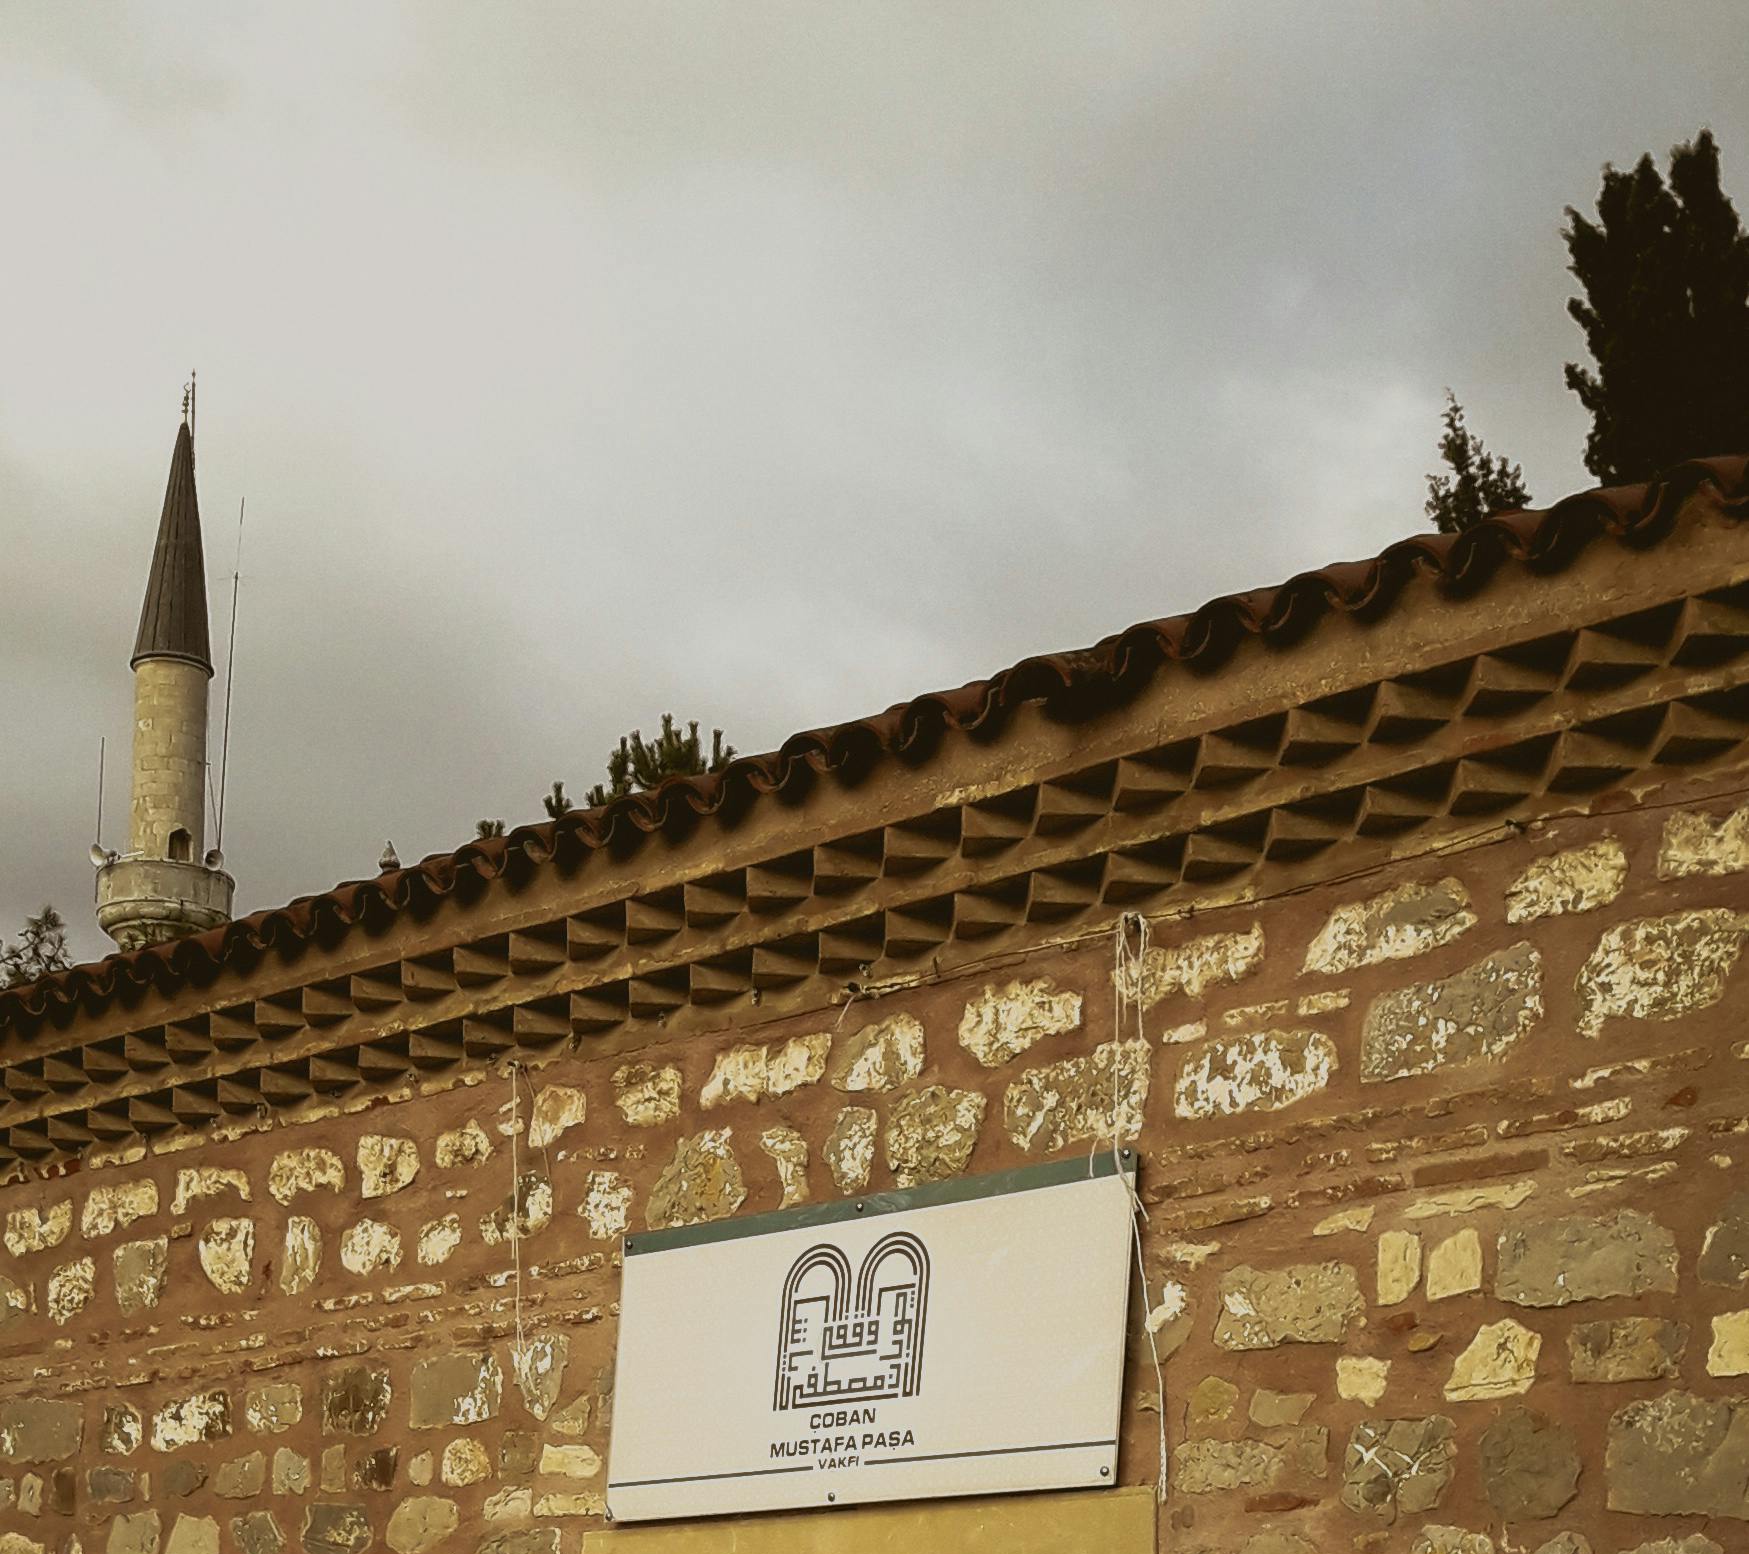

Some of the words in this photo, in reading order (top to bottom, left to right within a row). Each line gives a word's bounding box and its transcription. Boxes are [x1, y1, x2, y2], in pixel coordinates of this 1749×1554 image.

[809, 1408, 876, 1433] ÇOBAN
[769, 1435, 858, 1459] MUSTAFA
[861, 1429, 915, 1450] PAŞA
[818, 1455, 860, 1470] VAKFI
